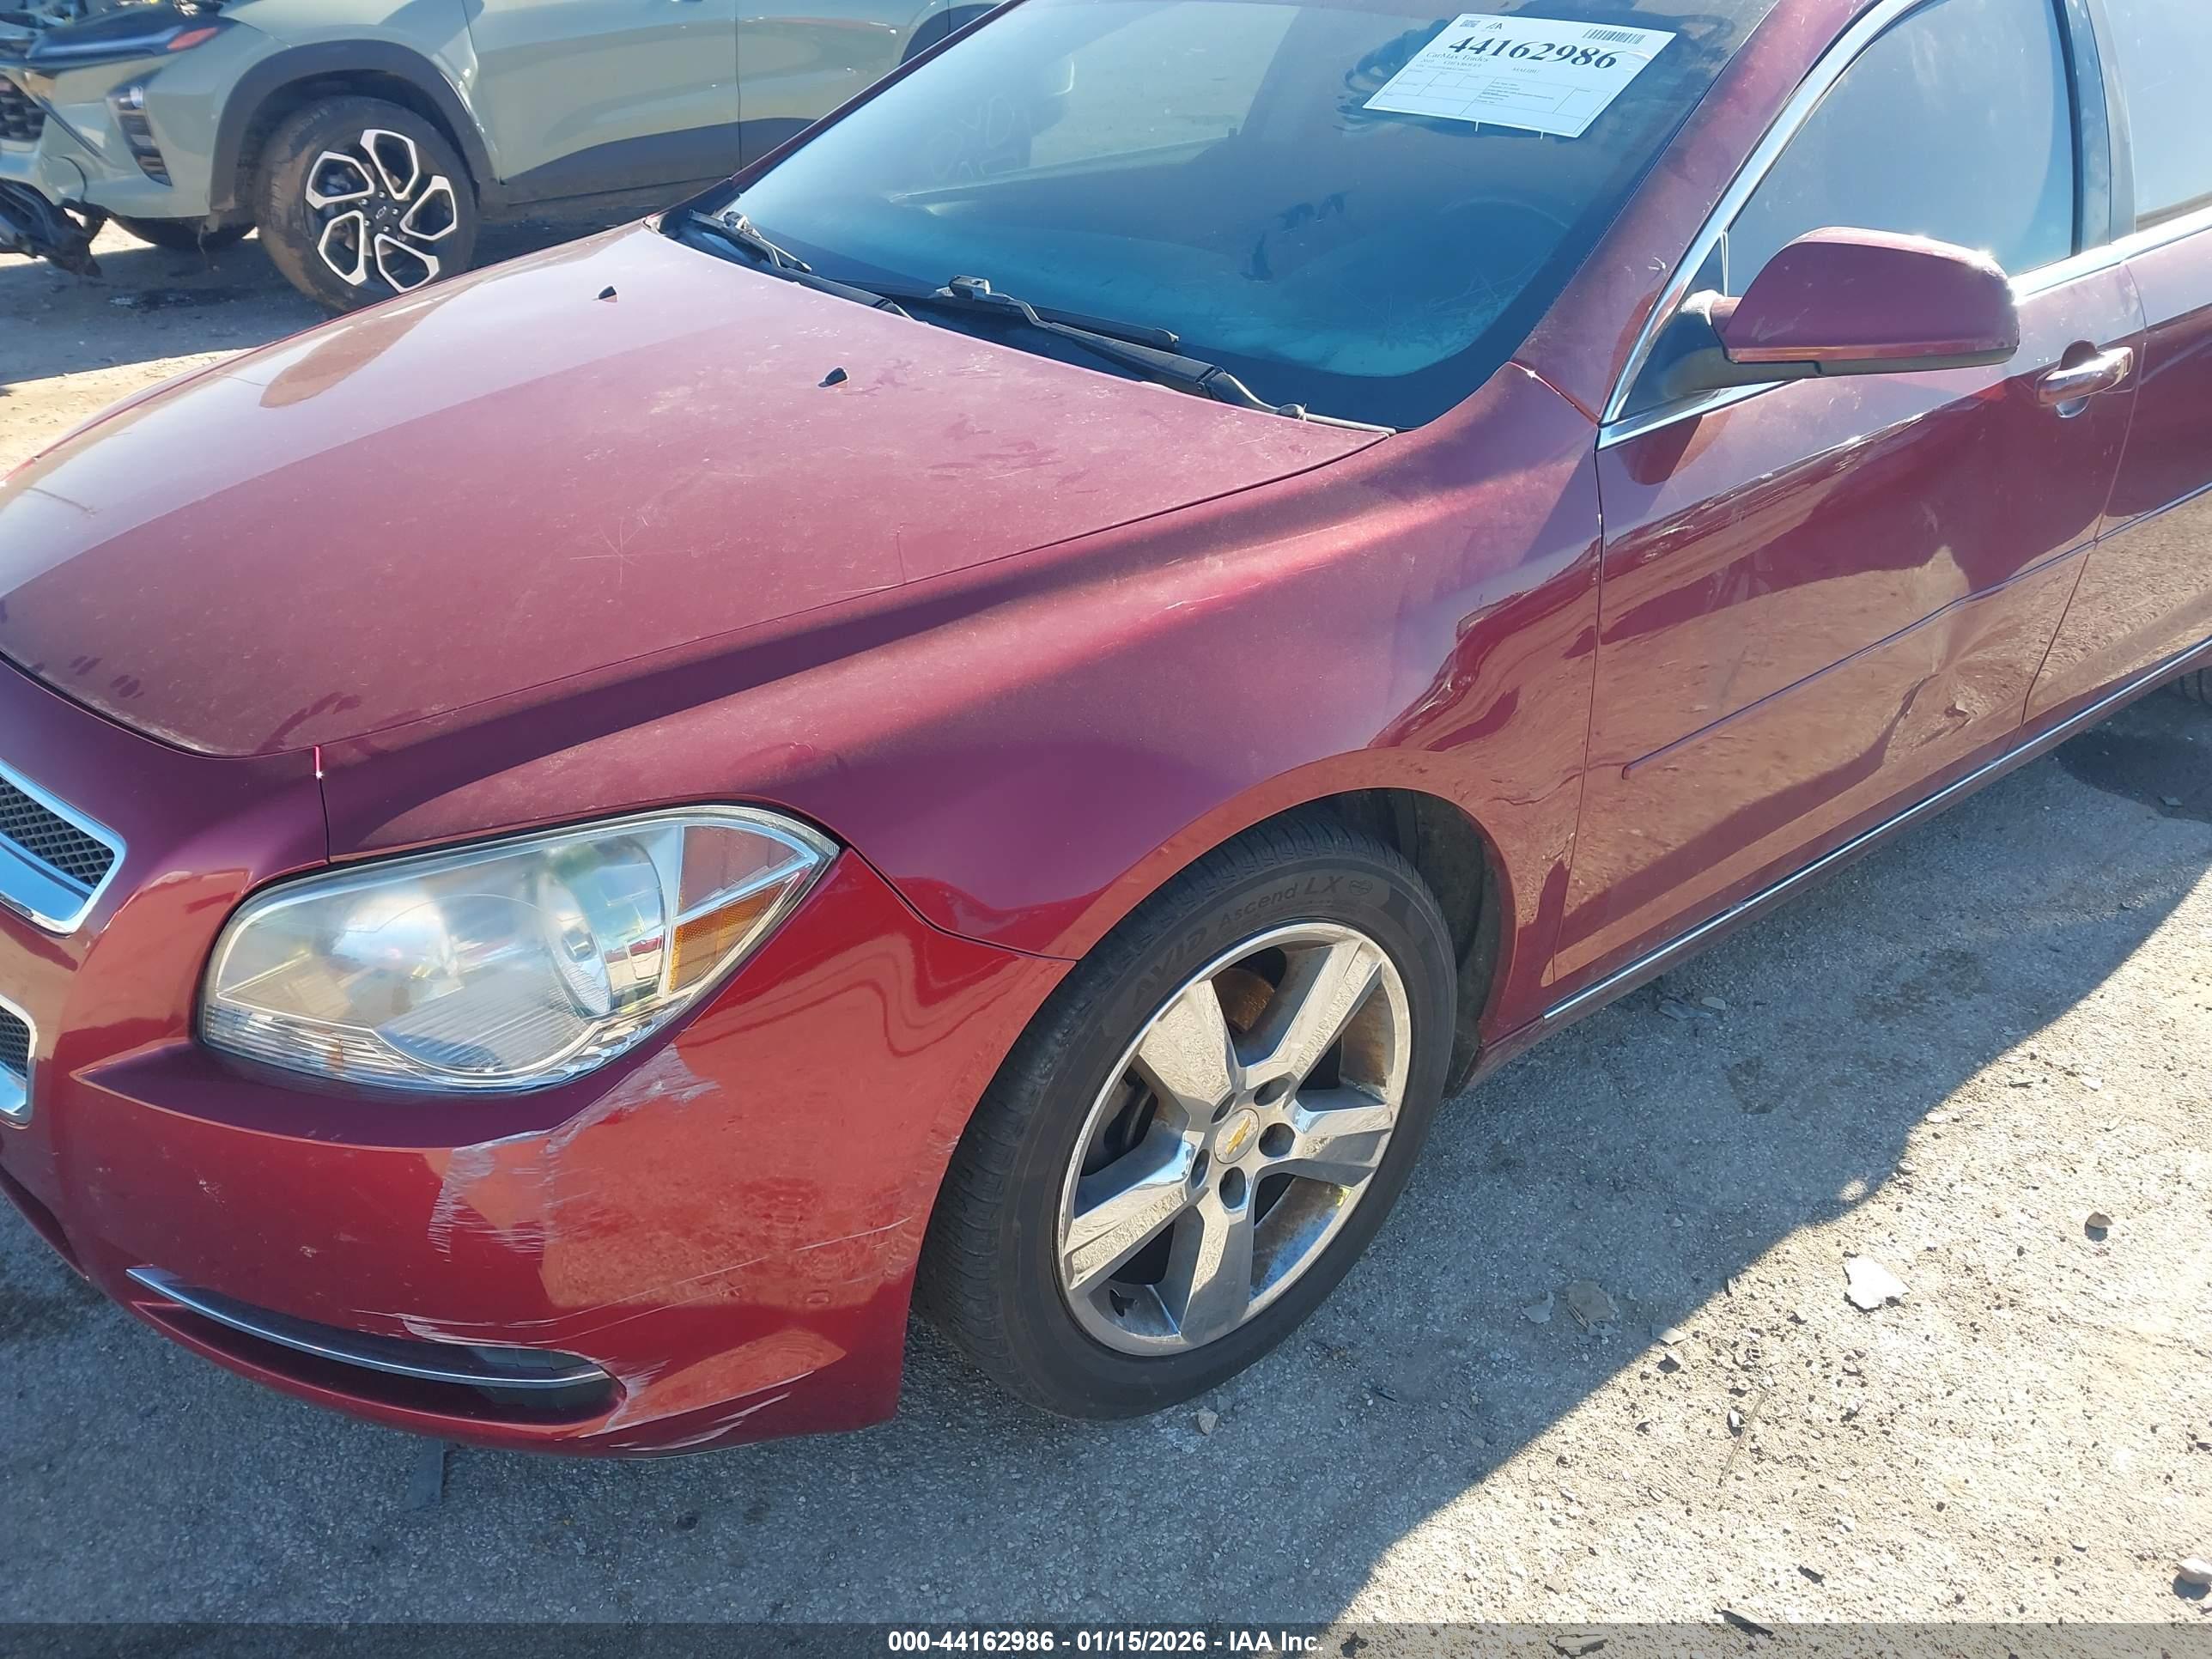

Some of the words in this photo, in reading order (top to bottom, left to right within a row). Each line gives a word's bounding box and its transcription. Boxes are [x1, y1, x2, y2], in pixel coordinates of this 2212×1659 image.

[1425, 52, 1461, 61] CarMax
[1448, 35, 1627, 70] 44162986
[1131, 927, 1207, 1006] AVID
[1219, 882, 1298, 927] Ascend
[1304, 875, 1344, 896] LX
